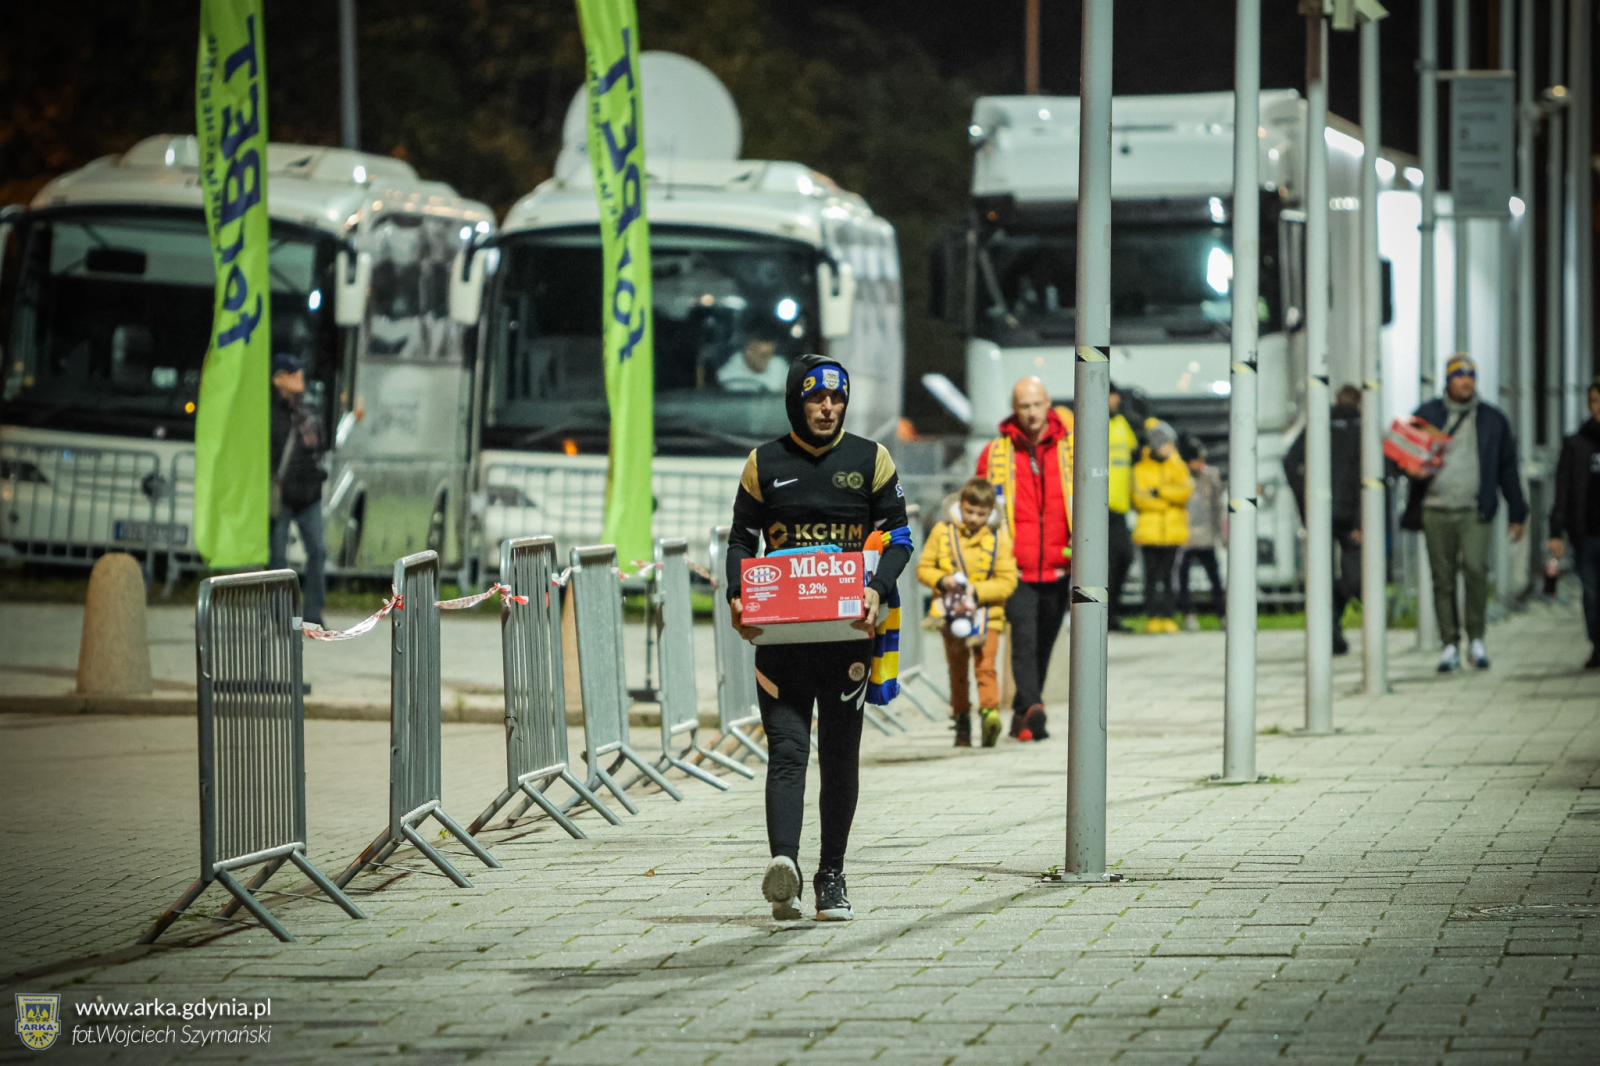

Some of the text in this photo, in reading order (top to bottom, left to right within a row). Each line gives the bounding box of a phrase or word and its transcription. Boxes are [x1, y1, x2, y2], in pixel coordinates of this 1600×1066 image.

[795, 523, 863, 540] KGHM
[789, 555, 857, 578] Mleko
[798, 582, 828, 595] 3,2%
